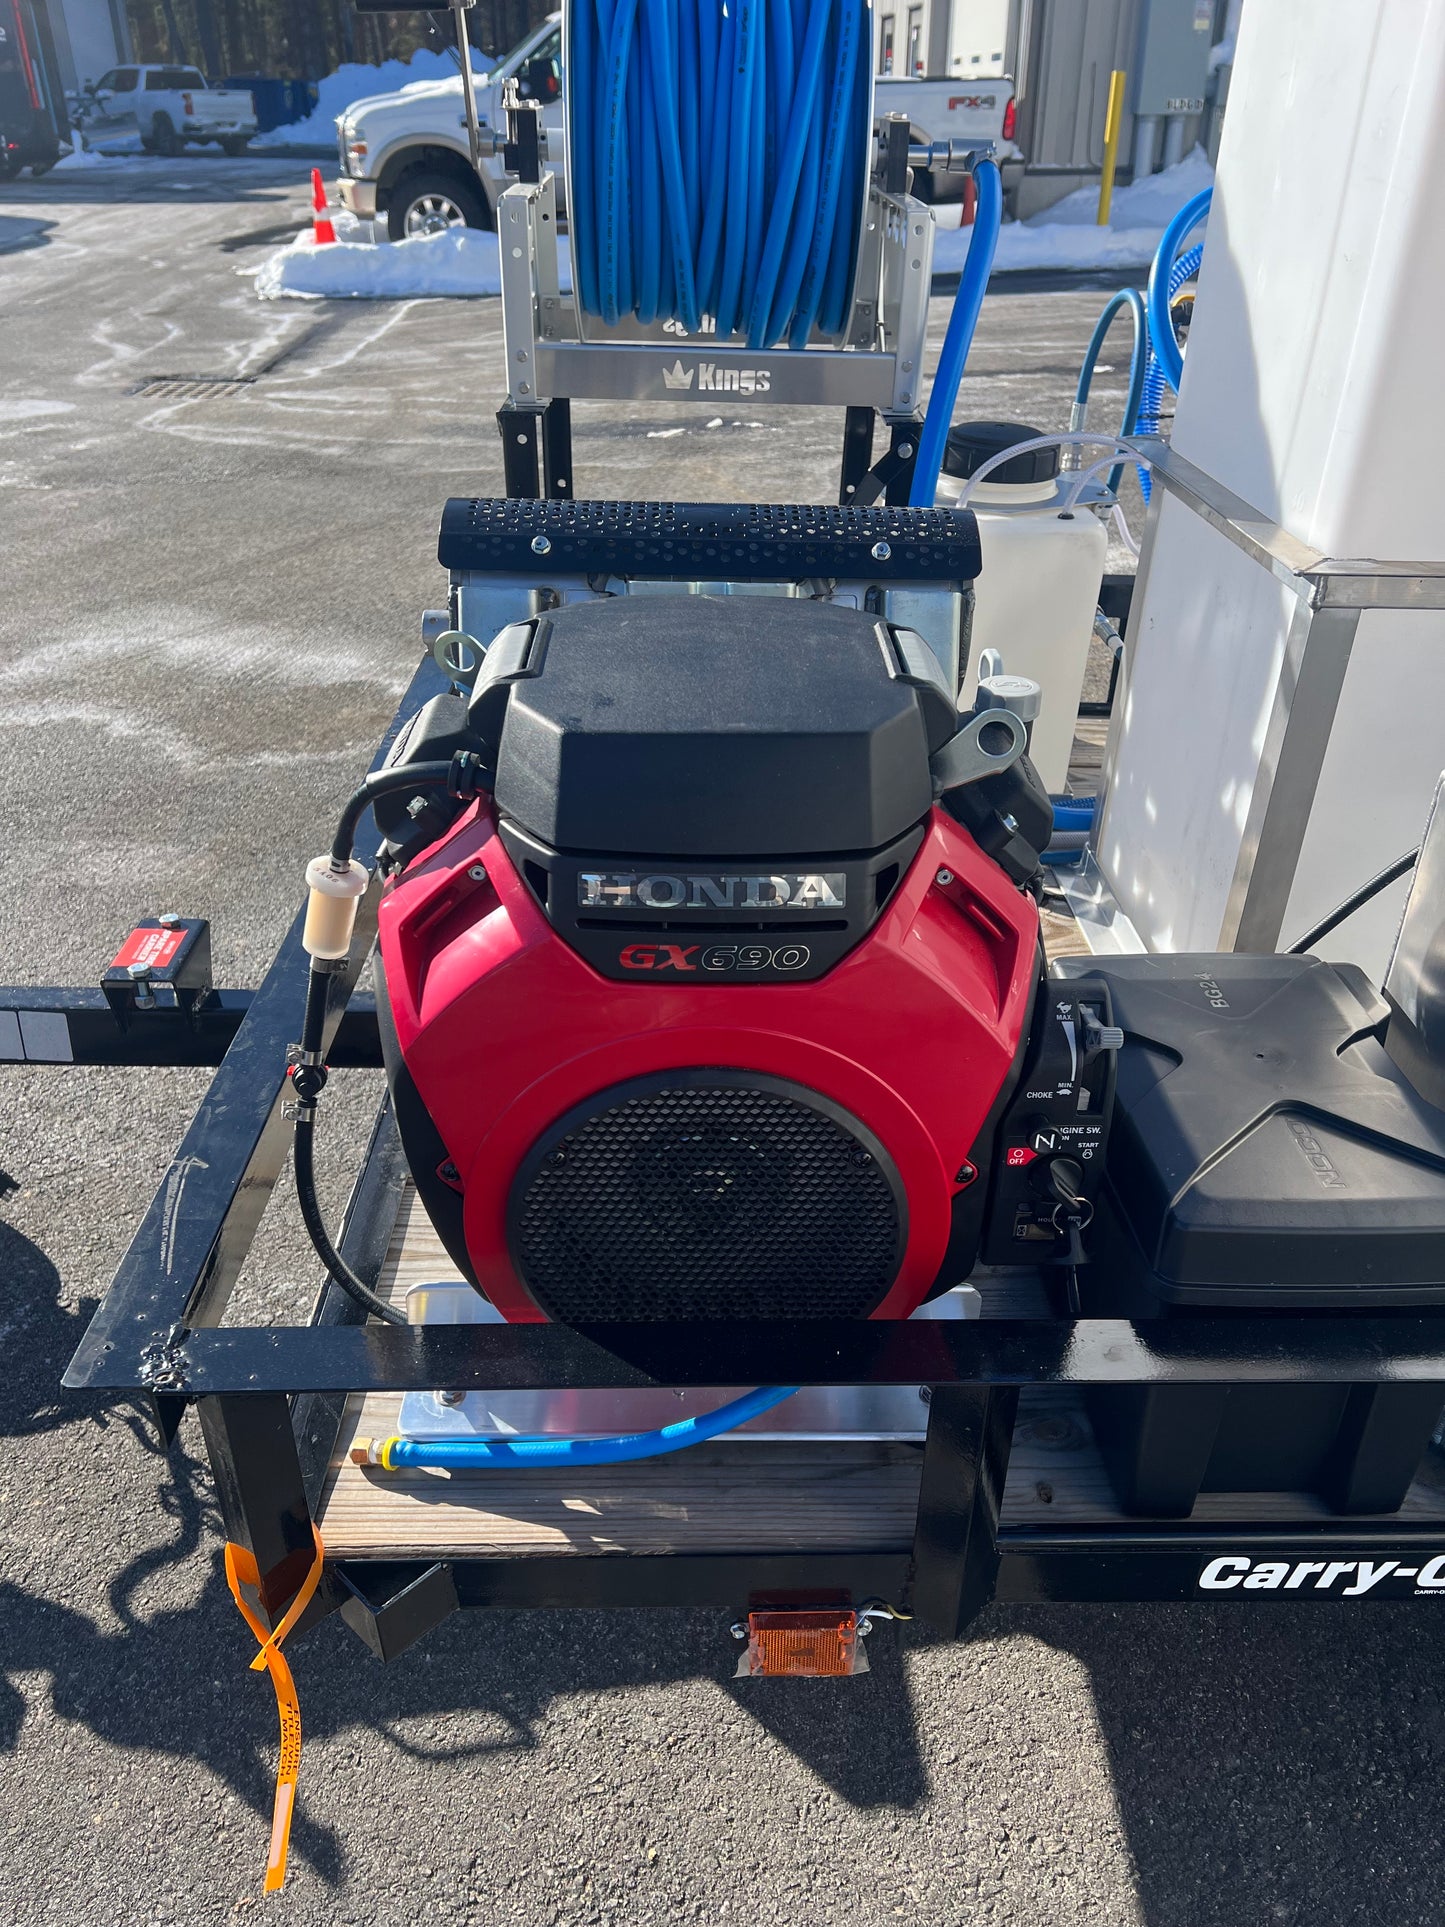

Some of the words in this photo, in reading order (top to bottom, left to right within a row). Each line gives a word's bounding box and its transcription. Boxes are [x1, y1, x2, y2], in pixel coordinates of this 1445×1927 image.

[698, 363, 771, 396] Kings
[581, 873, 843, 909] HONDA
[618, 944, 811, 971] GX690
[1193, 972, 1230, 1008] BG24
[1026, 1091, 1054, 1099] CHOKE
[280, 1719, 288, 1776] MATCH
[286, 1700, 295, 1776] TITLE/VIN
[292, 1709, 300, 1775] ENSURE
